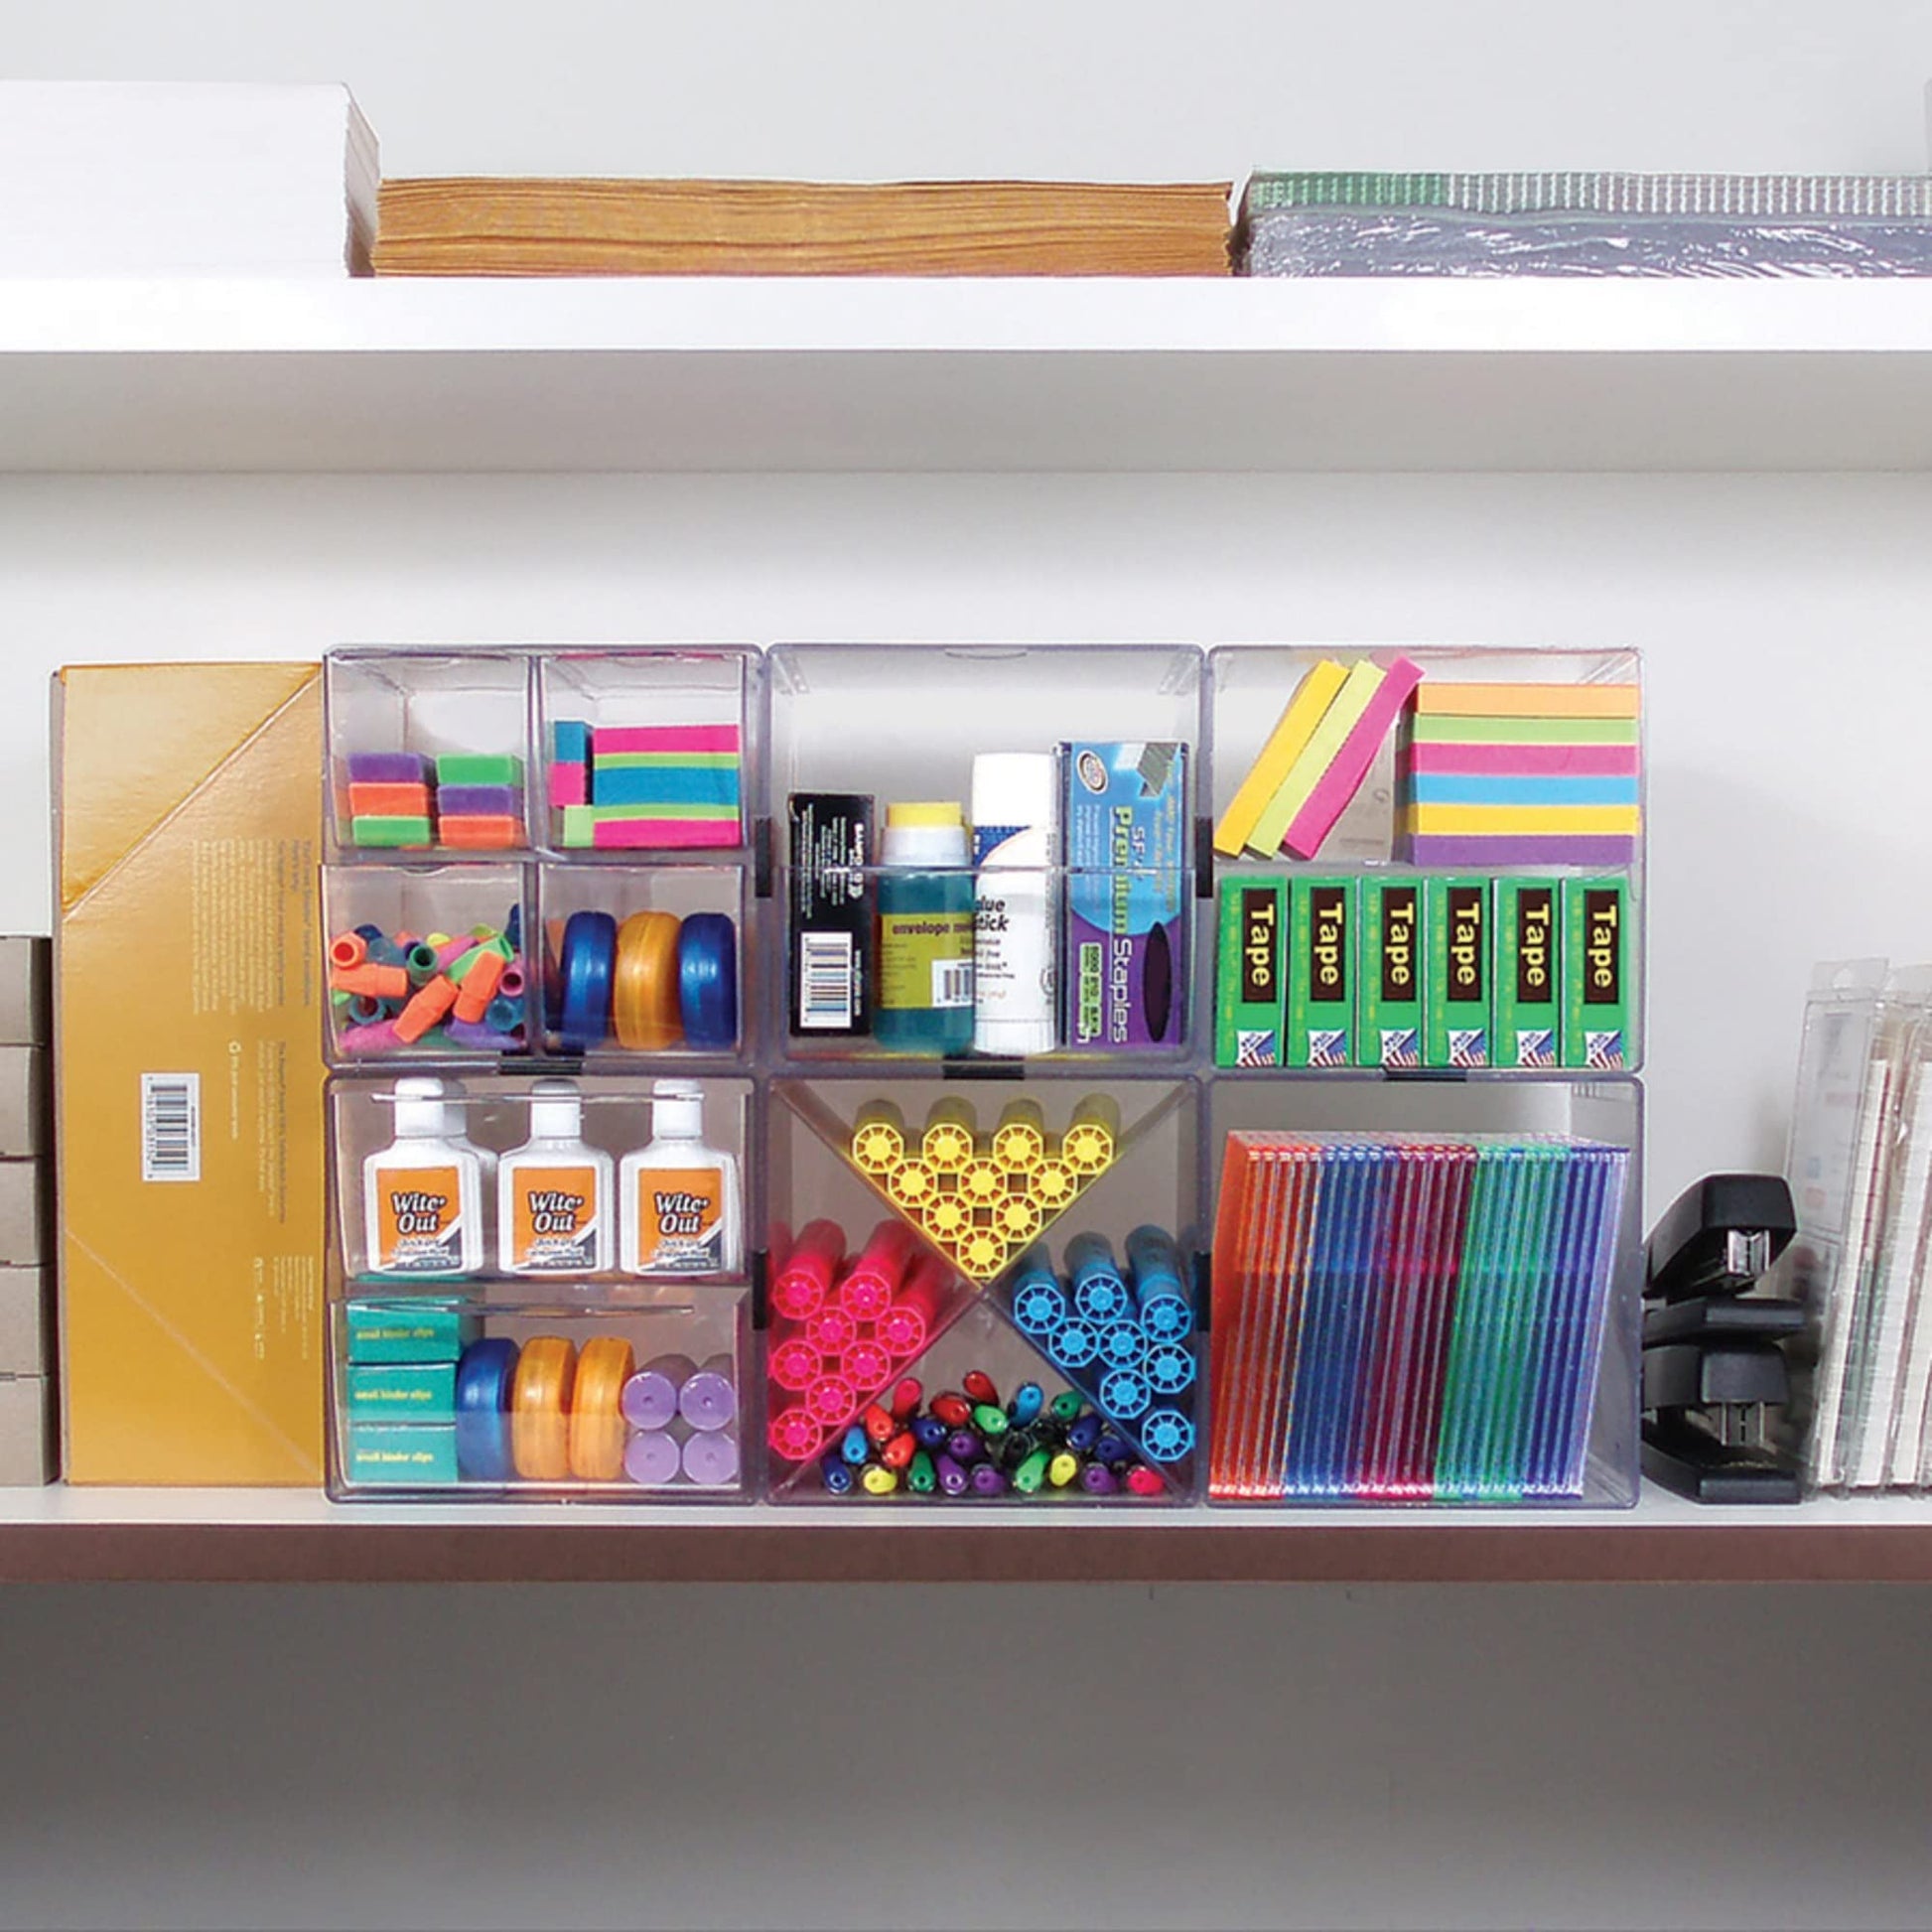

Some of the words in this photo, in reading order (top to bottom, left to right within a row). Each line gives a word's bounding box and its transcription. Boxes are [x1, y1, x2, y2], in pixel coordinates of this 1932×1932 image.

[1113, 805, 1133, 934] Premium
[893, 920, 950, 936] envelope
[975, 914, 1010, 931] tick
[1246, 903, 1274, 987] Tape
[1313, 902, 1342, 986] Tape
[1385, 902, 1414, 985] Tape
[1450, 902, 1479, 986] Tape
[1520, 903, 1549, 987] Tape
[1588, 904, 1617, 988] Tape
[1109, 938, 1133, 1043] Staples
